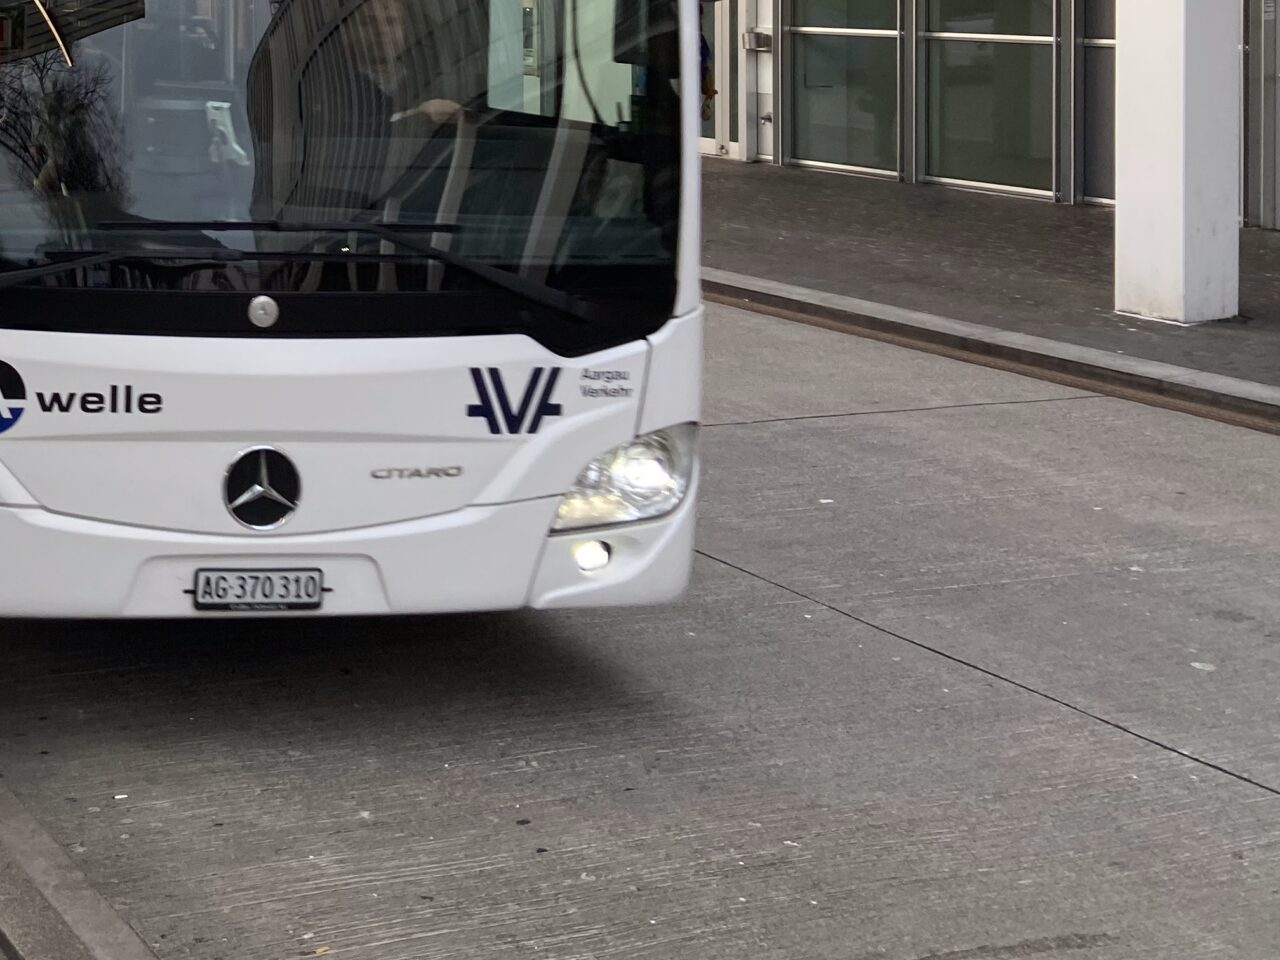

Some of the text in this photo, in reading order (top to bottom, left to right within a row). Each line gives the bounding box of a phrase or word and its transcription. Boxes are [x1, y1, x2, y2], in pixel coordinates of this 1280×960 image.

[581, 368, 629, 383] Aargau
[580, 384, 634, 398] Verkehr
[35, 384, 164, 414] welle
[370, 465, 464, 480] CITARO
